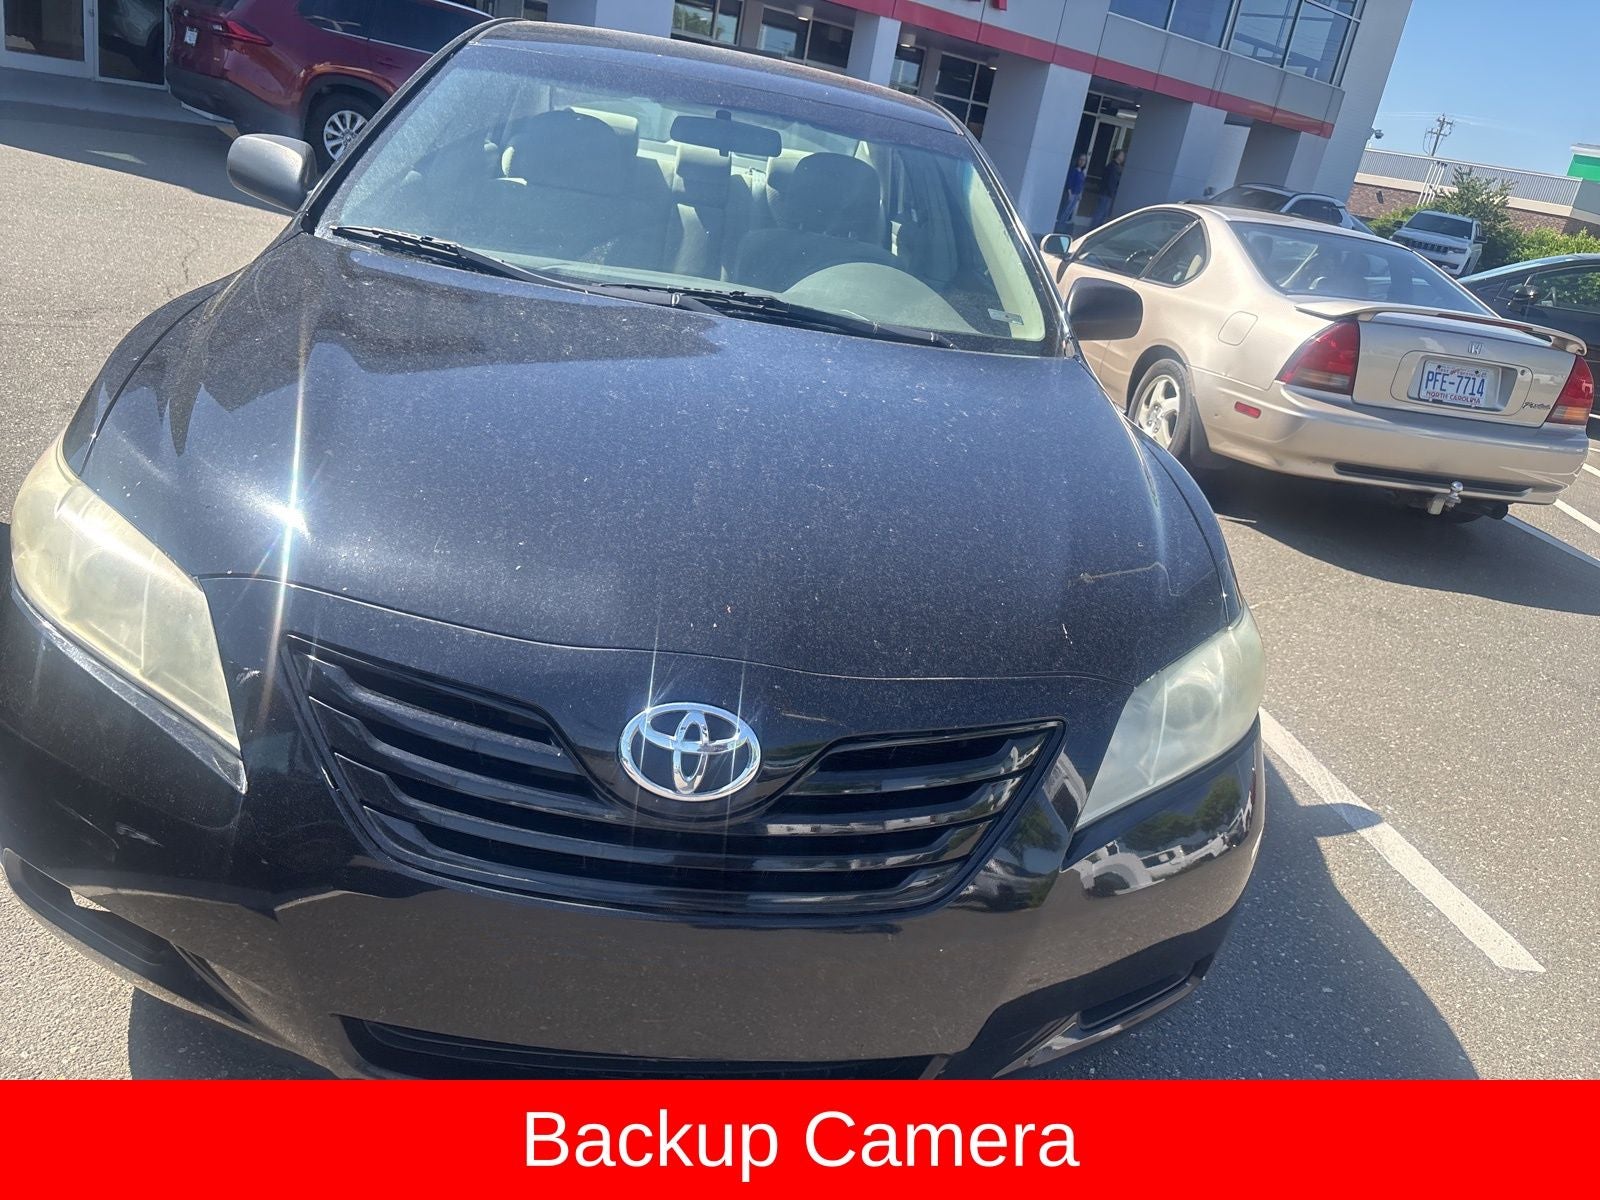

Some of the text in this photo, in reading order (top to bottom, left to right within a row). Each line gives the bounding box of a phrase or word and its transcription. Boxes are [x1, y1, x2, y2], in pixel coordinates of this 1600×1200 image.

[1424, 370, 1485, 397] PFE-7714
[1426, 391, 1481, 405] NORTH CAROLINA
